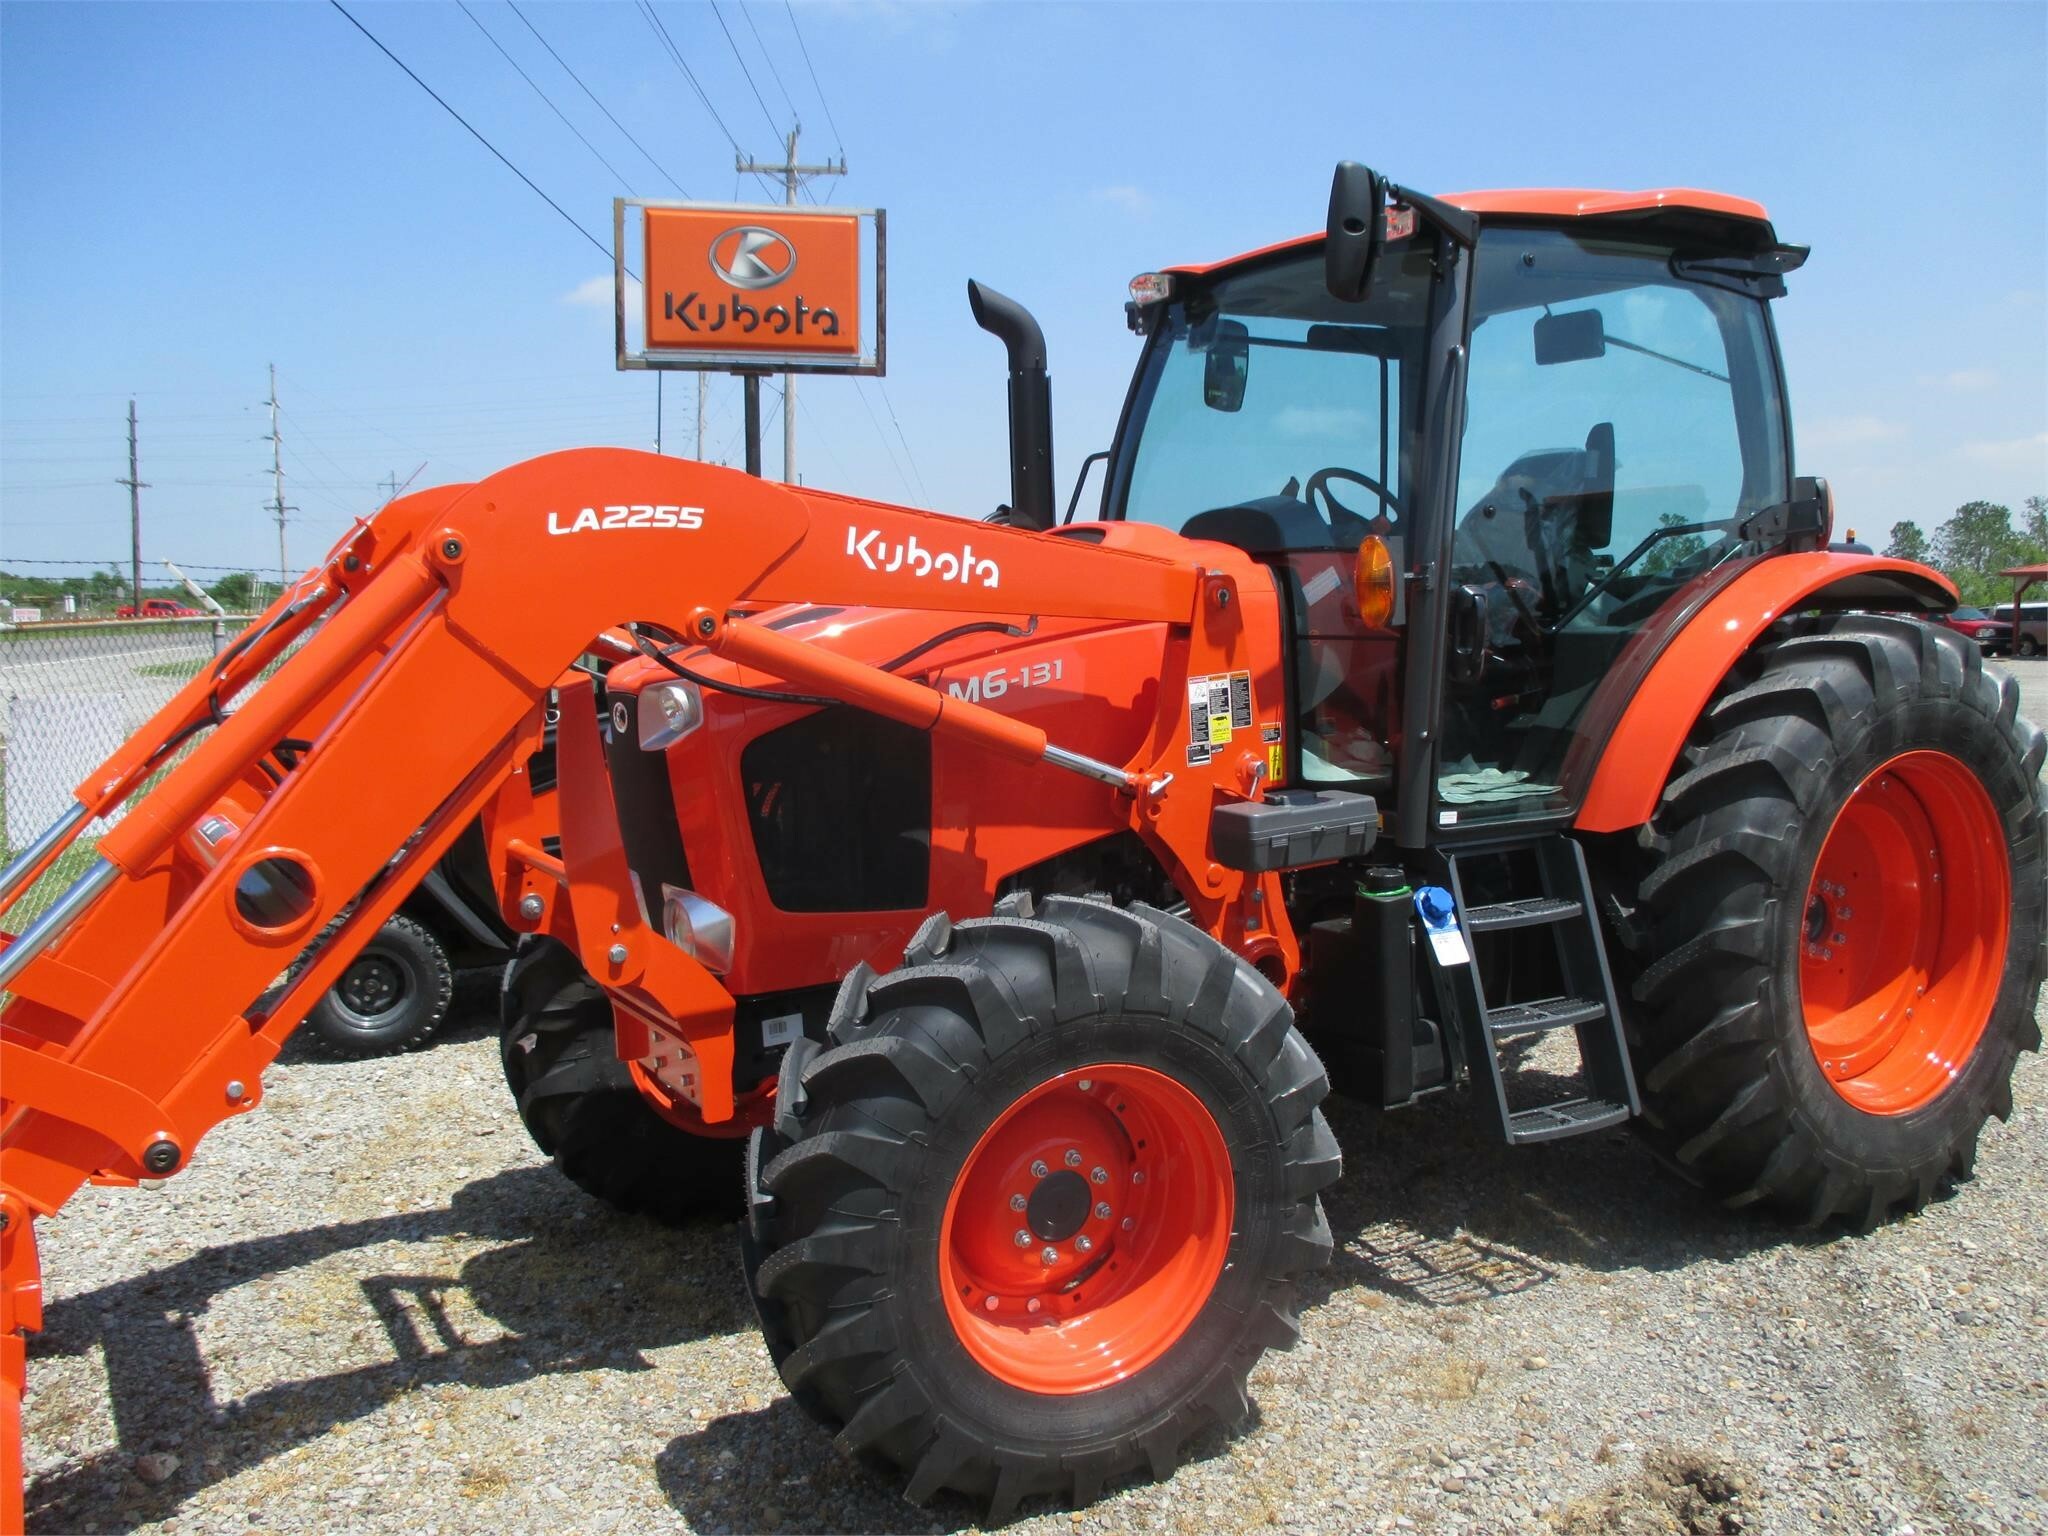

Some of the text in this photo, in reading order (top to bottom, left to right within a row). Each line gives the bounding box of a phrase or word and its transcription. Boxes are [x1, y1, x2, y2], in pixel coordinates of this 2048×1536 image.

[664, 291, 839, 336] Kubota
[547, 505, 705, 536] LA2255
[846, 525, 1000, 589] Kubota
[948, 658, 1064, 704] M6-131
